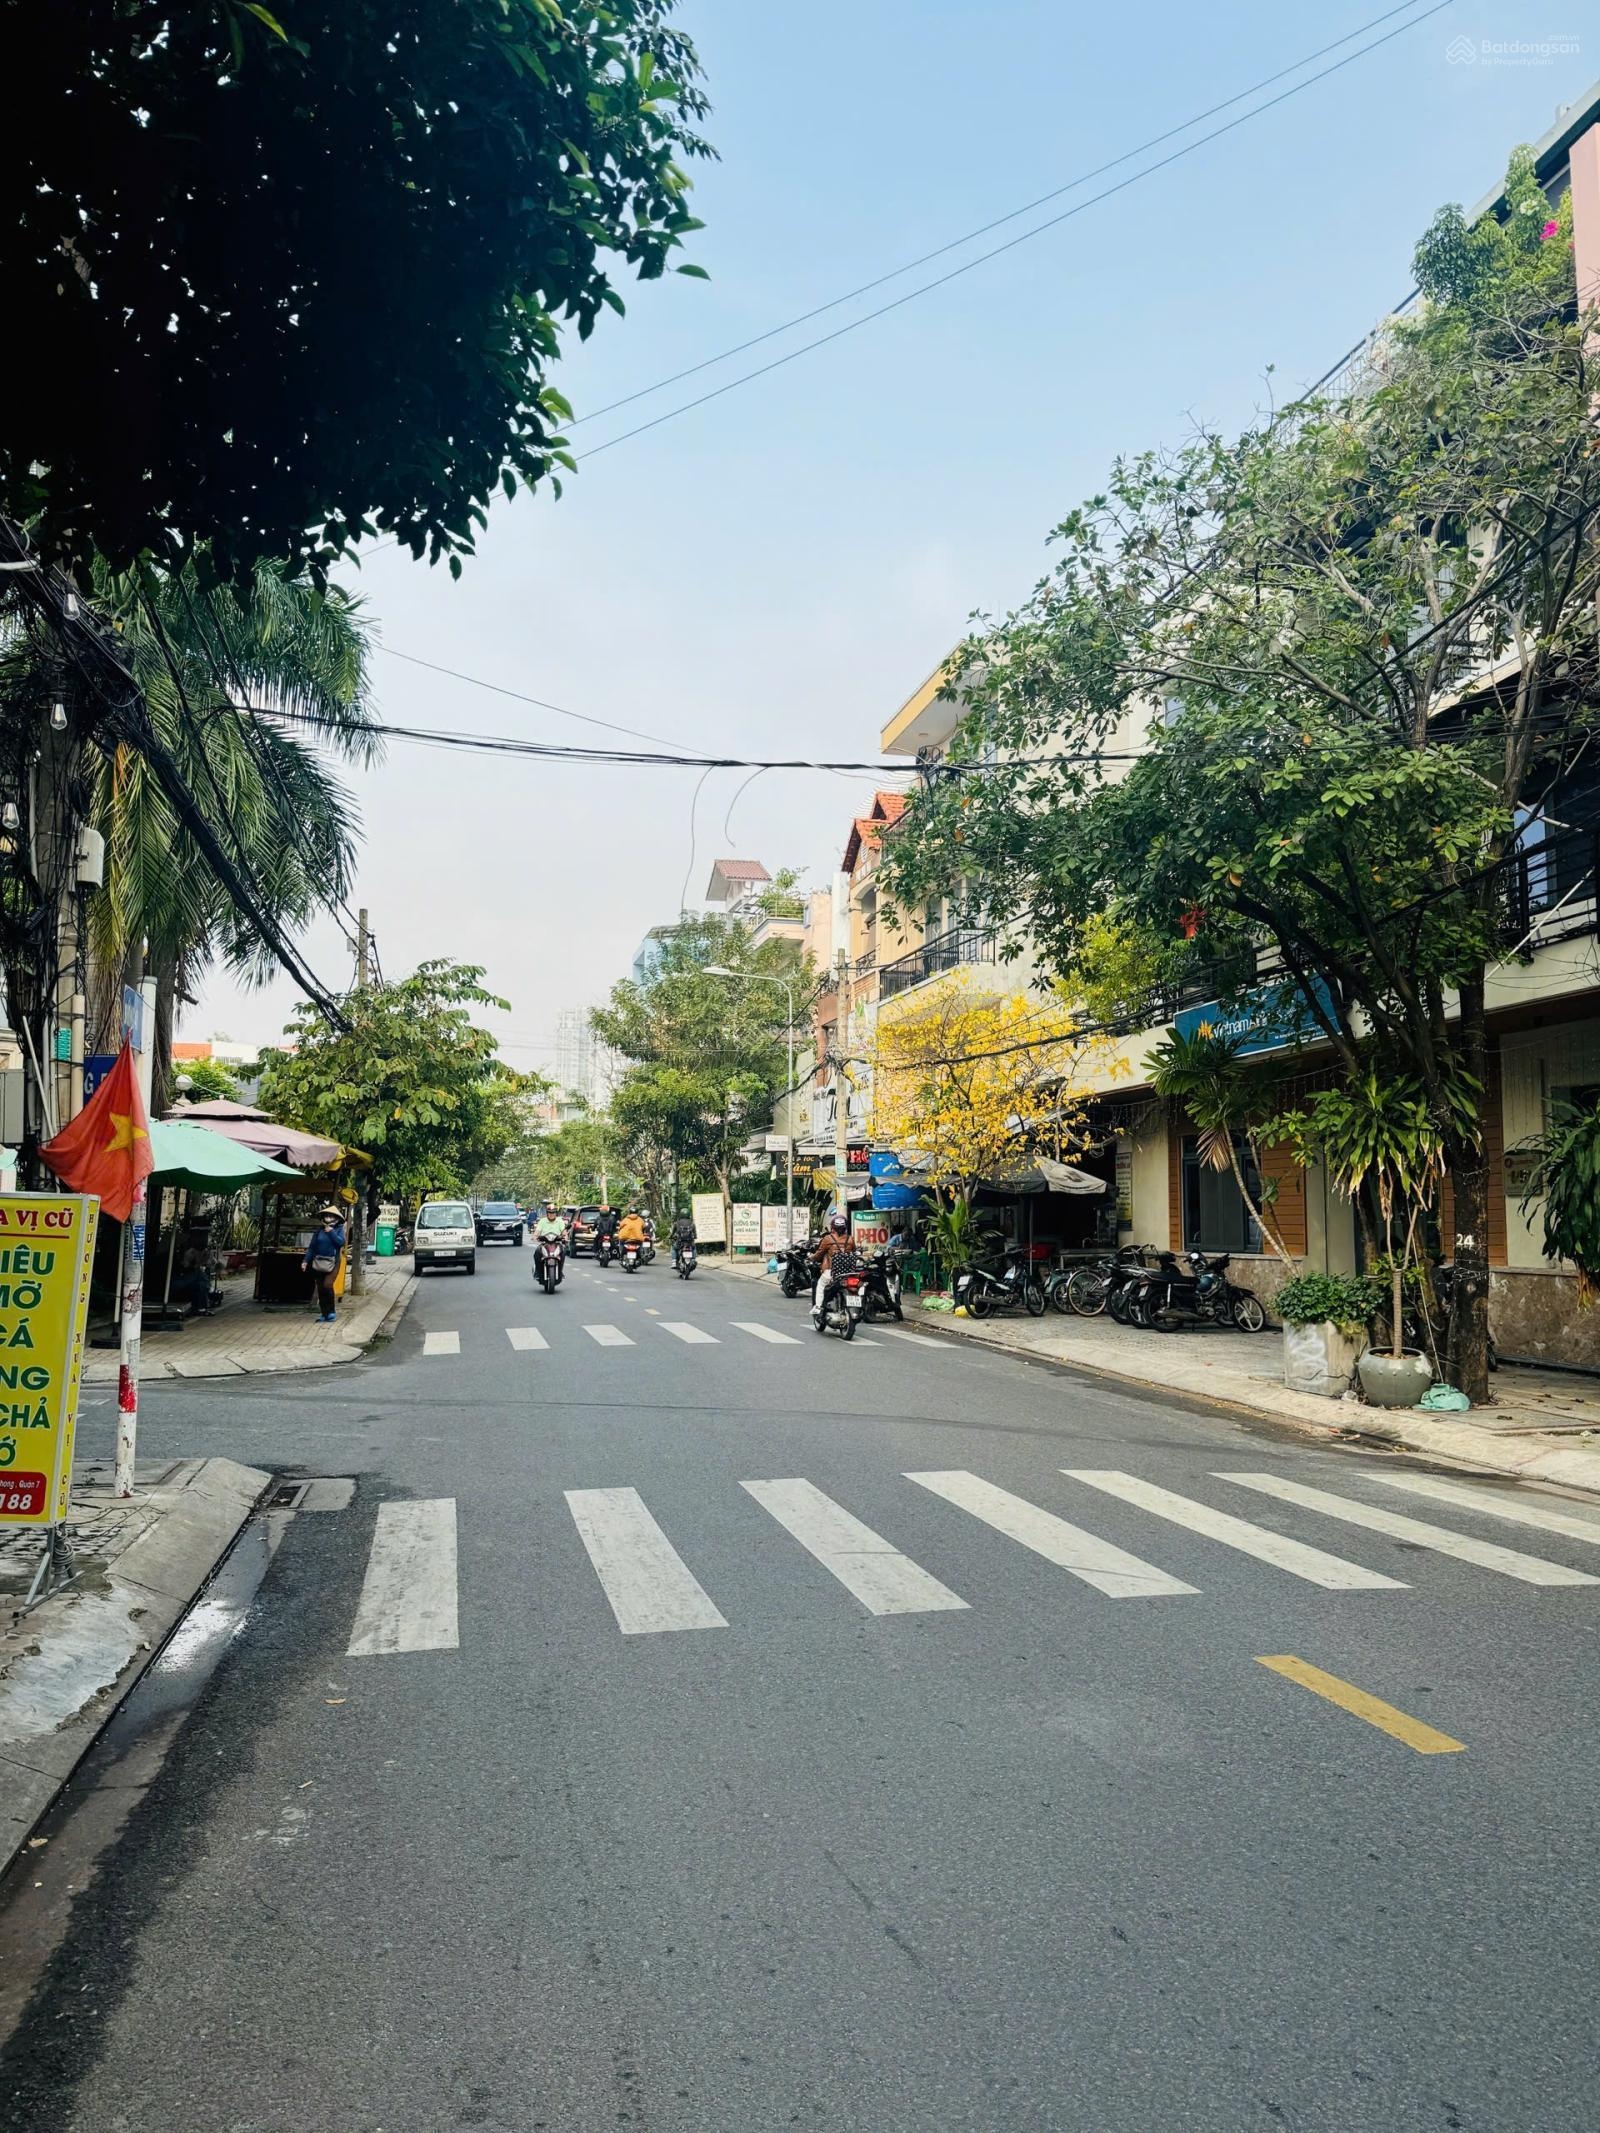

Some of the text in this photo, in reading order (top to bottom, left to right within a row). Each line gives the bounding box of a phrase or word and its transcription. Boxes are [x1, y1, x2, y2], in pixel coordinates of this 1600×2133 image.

[16, 1209, 38, 1231] VỊ
[44, 1207, 74, 1228] CŨ
[856, 1222, 889, 1244] PHỞ
[1456, 1234, 1474, 1246] 24
